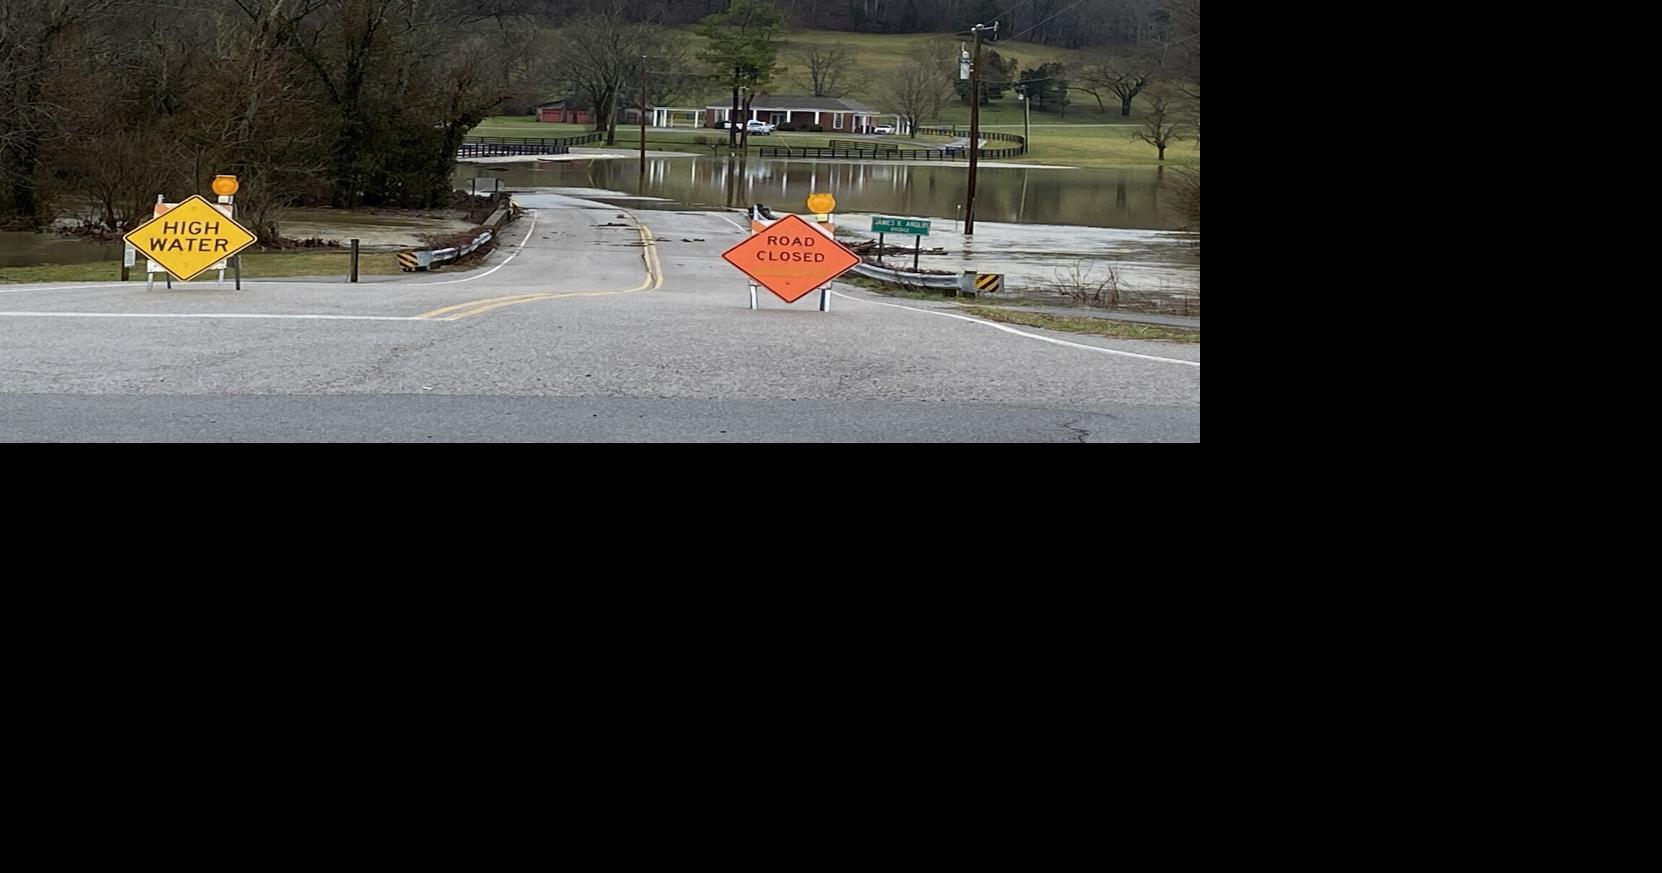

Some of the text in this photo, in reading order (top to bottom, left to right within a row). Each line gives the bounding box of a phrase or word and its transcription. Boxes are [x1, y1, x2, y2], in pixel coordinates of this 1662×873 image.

[163, 221, 219, 235] HIGH
[150, 238, 229, 252] WATER
[767, 235, 815, 247] ROAD
[756, 250, 825, 263] CLOSED
